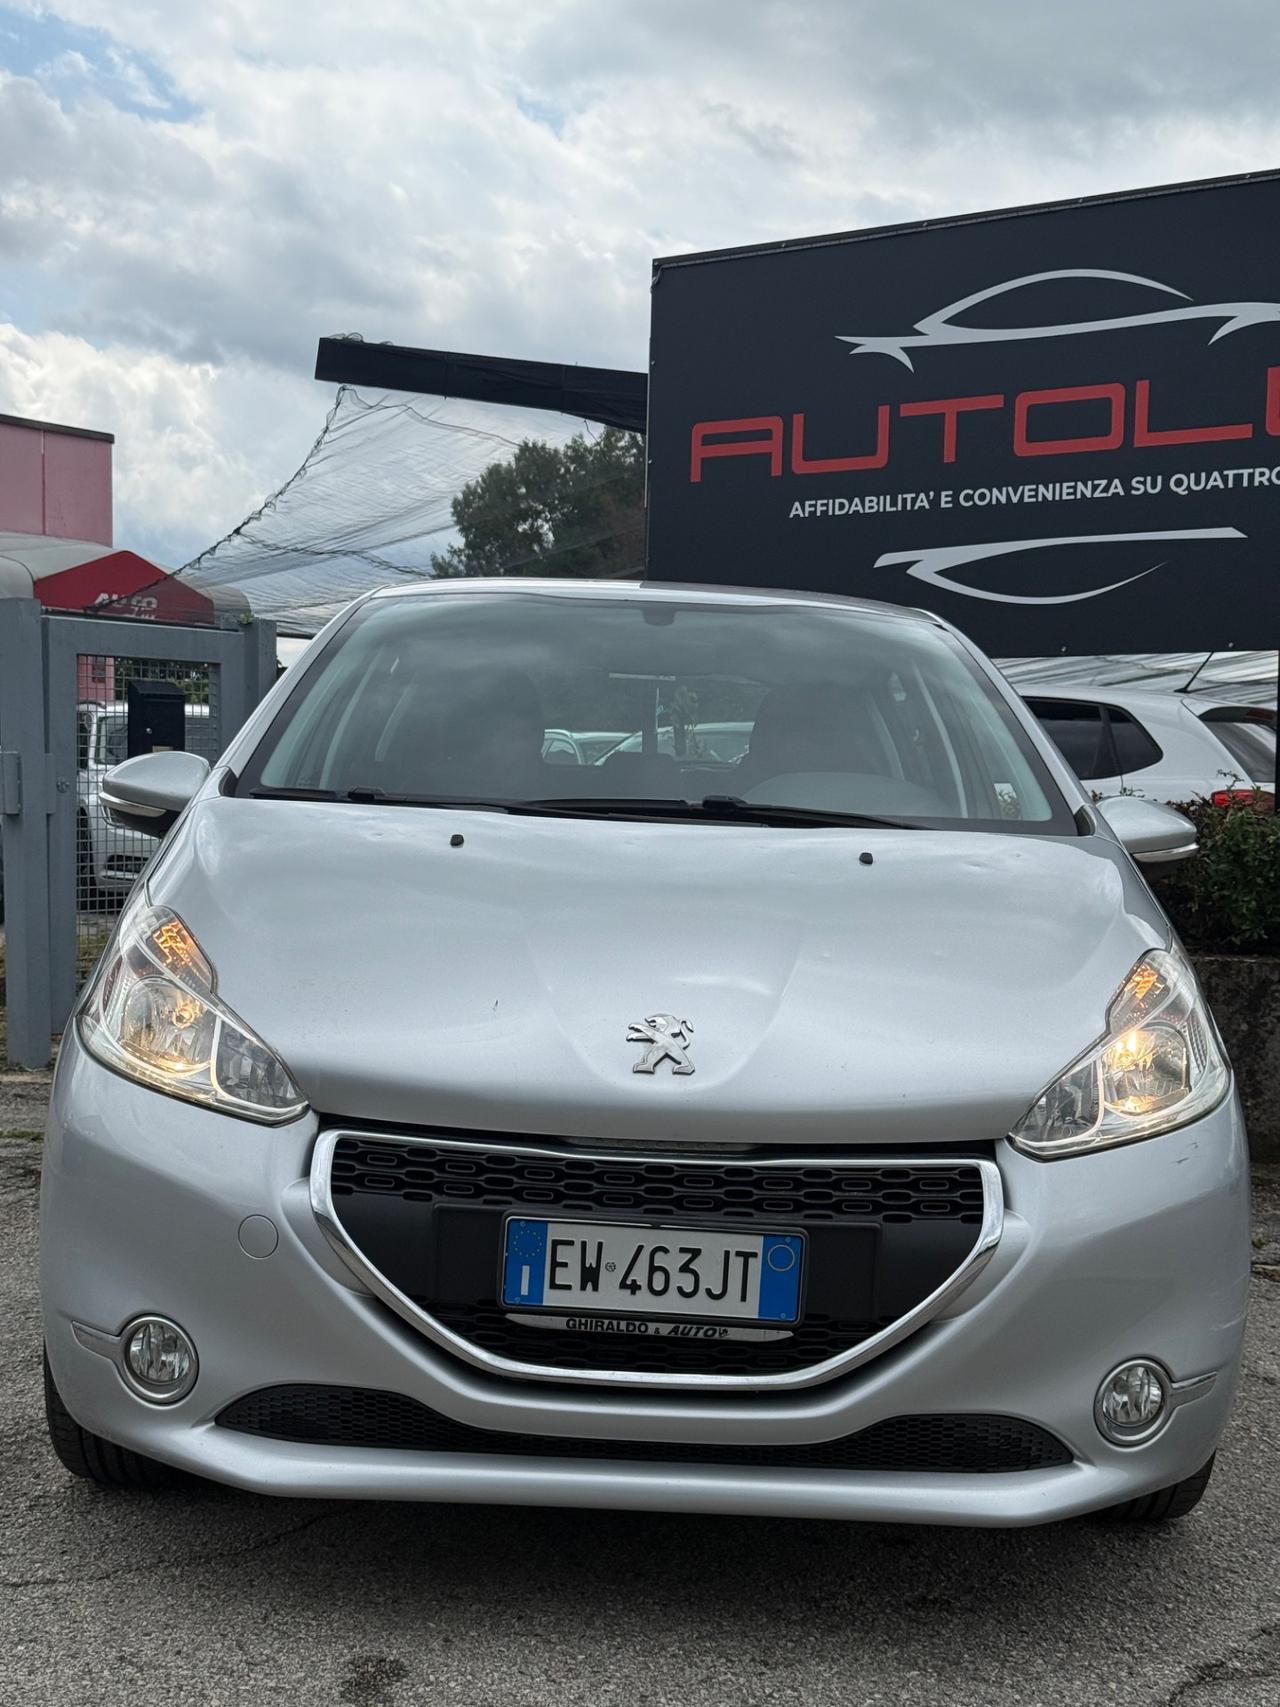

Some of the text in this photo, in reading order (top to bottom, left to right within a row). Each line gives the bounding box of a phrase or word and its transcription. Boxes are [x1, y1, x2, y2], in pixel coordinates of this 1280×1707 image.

[690, 365, 1280, 482] AUTOL
[940, 490, 953, 509] E
[959, 478, 1125, 507] CONVENIENZA
[1131, 475, 1162, 495] SU
[565, 1318, 649, 1335] GHIRALDO
